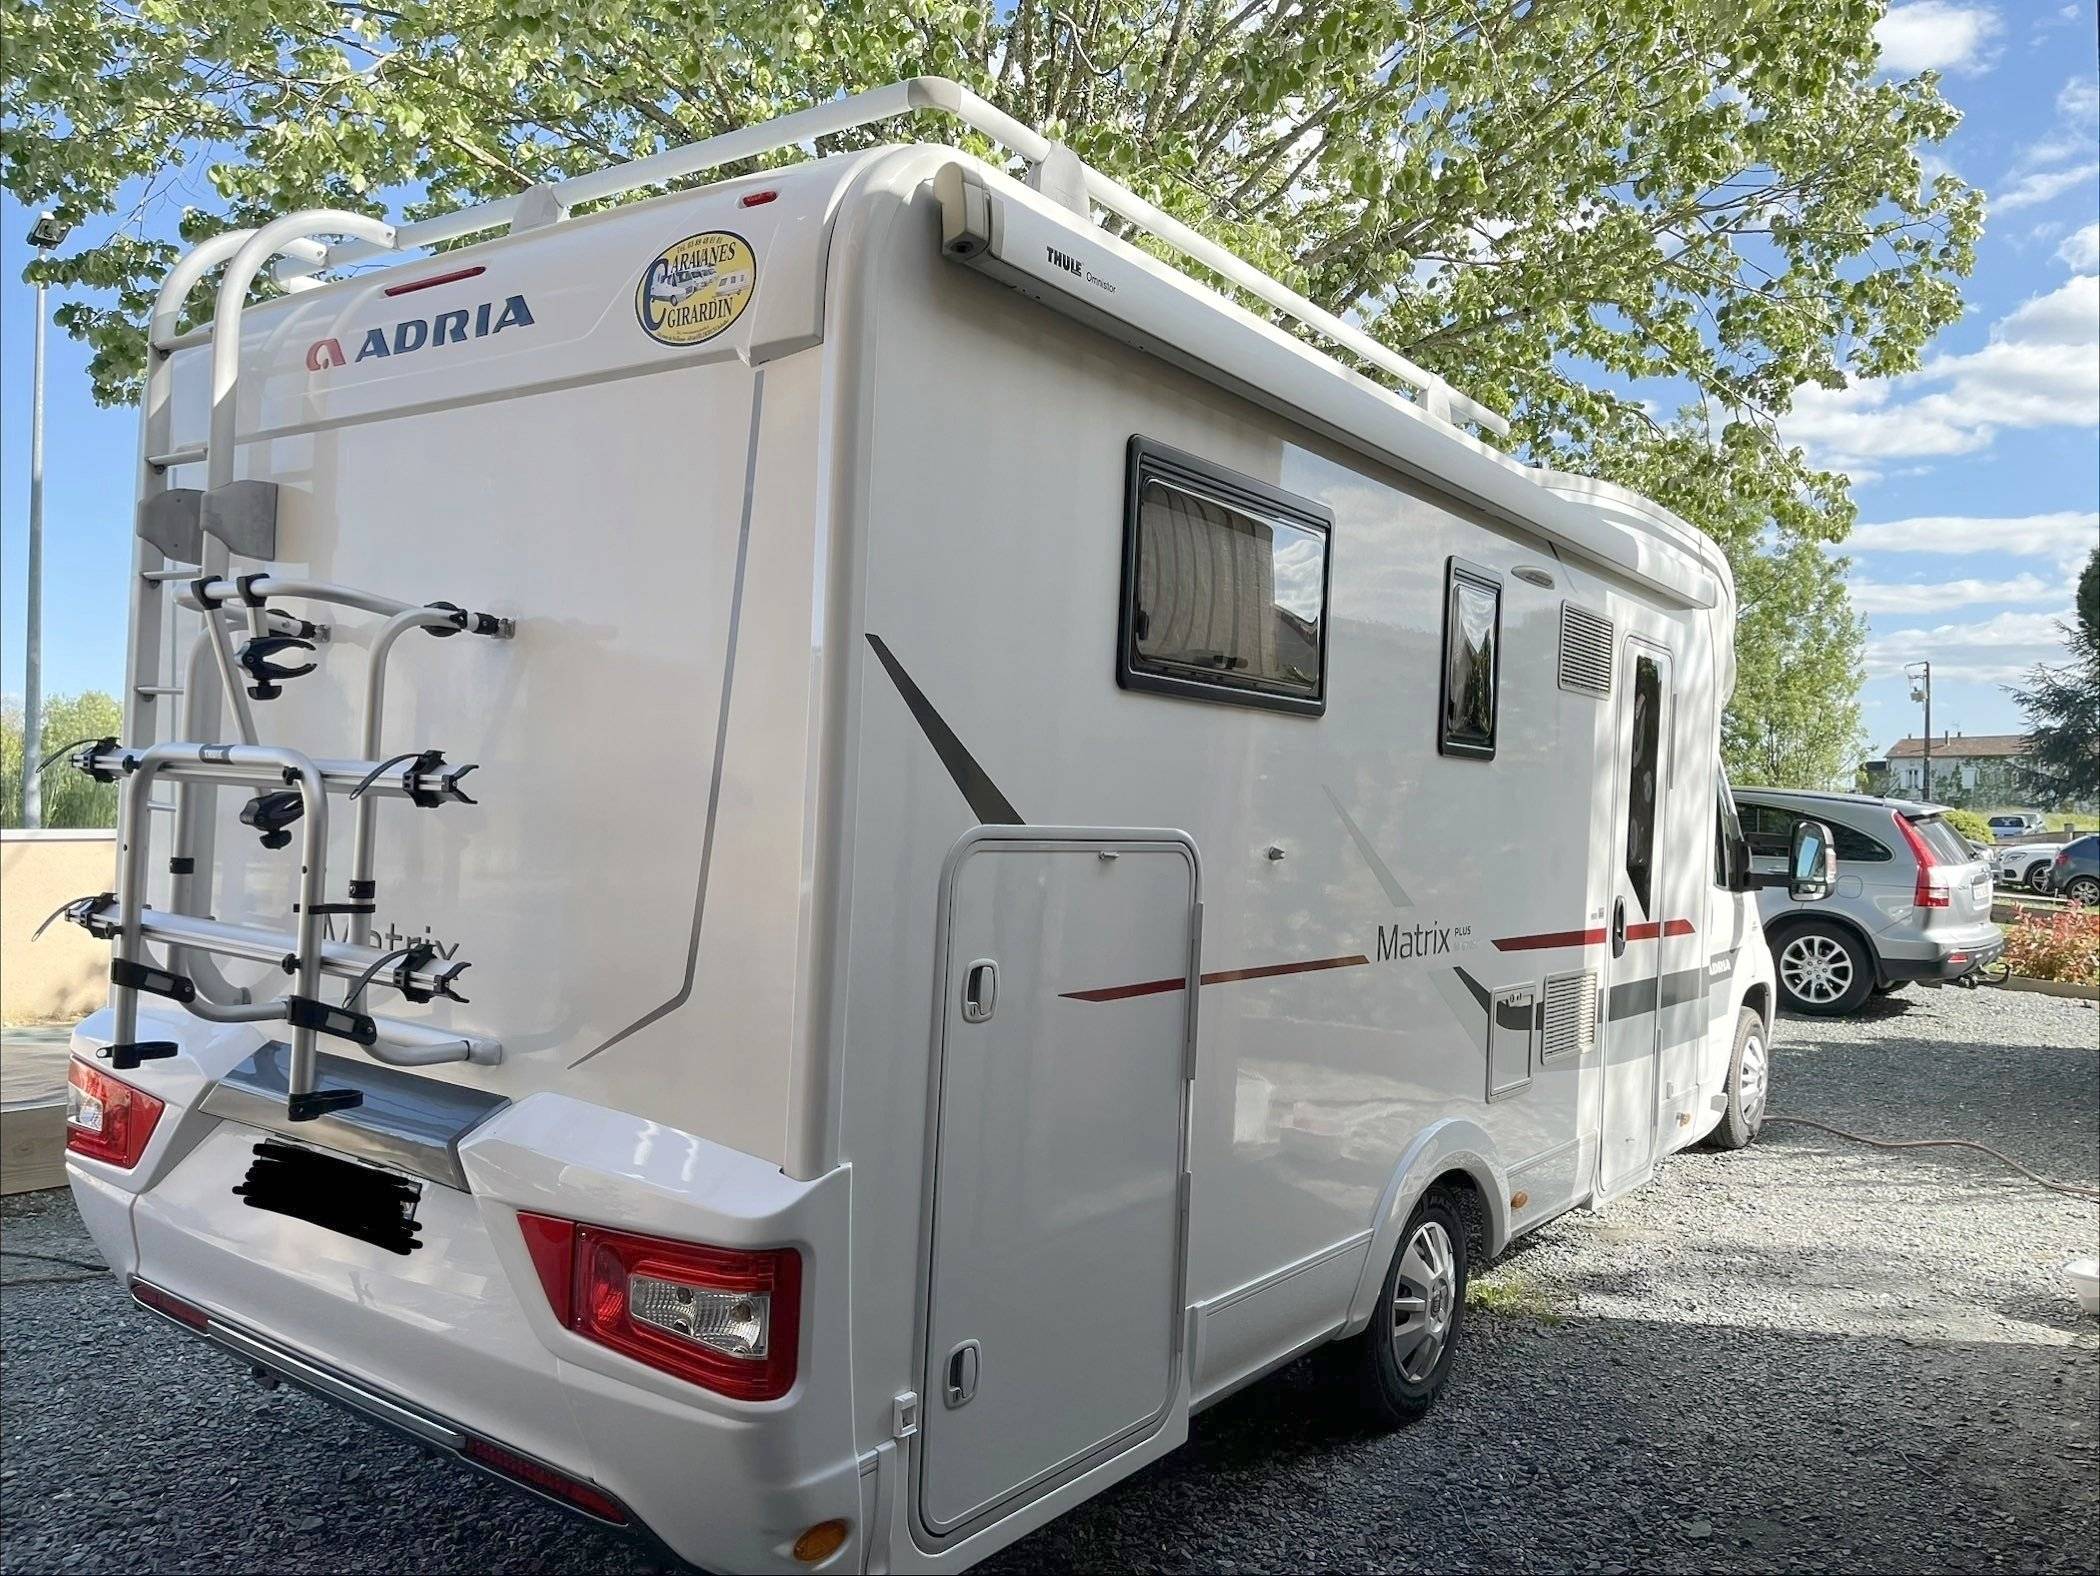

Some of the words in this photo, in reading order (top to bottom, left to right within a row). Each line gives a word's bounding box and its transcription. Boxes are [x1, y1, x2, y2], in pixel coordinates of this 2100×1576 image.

[1046, 246, 1083, 277] THULE
[1086, 271, 1117, 293] Omnistor
[354, 295, 535, 363] ADRIA
[667, 296, 734, 328] GIRARDIN
[1377, 921, 1451, 962] Matrix
[1454, 926, 1472, 937] PLUS
